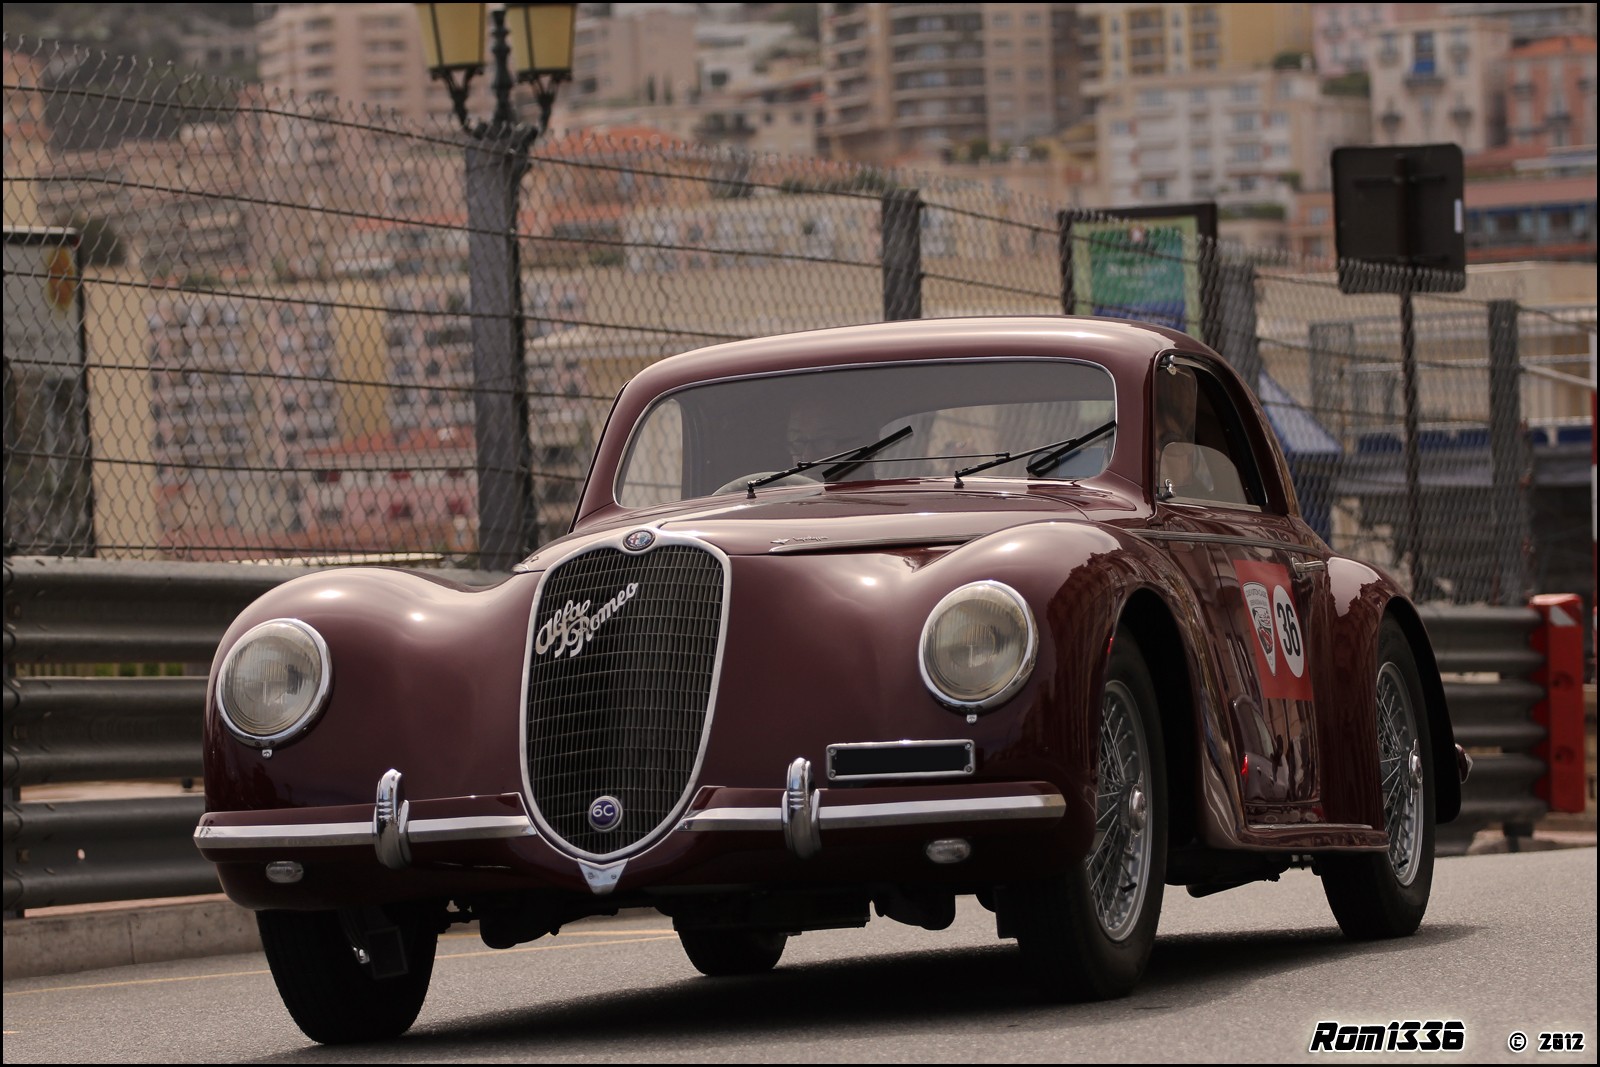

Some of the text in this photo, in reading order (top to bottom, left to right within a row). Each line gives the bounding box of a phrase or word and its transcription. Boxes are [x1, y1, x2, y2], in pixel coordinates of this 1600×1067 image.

[535, 599, 591, 658] Alfa
[564, 582, 639, 658] Romeo
[1276, 602, 1301, 656] 36
[592, 804, 614, 818] 6C
